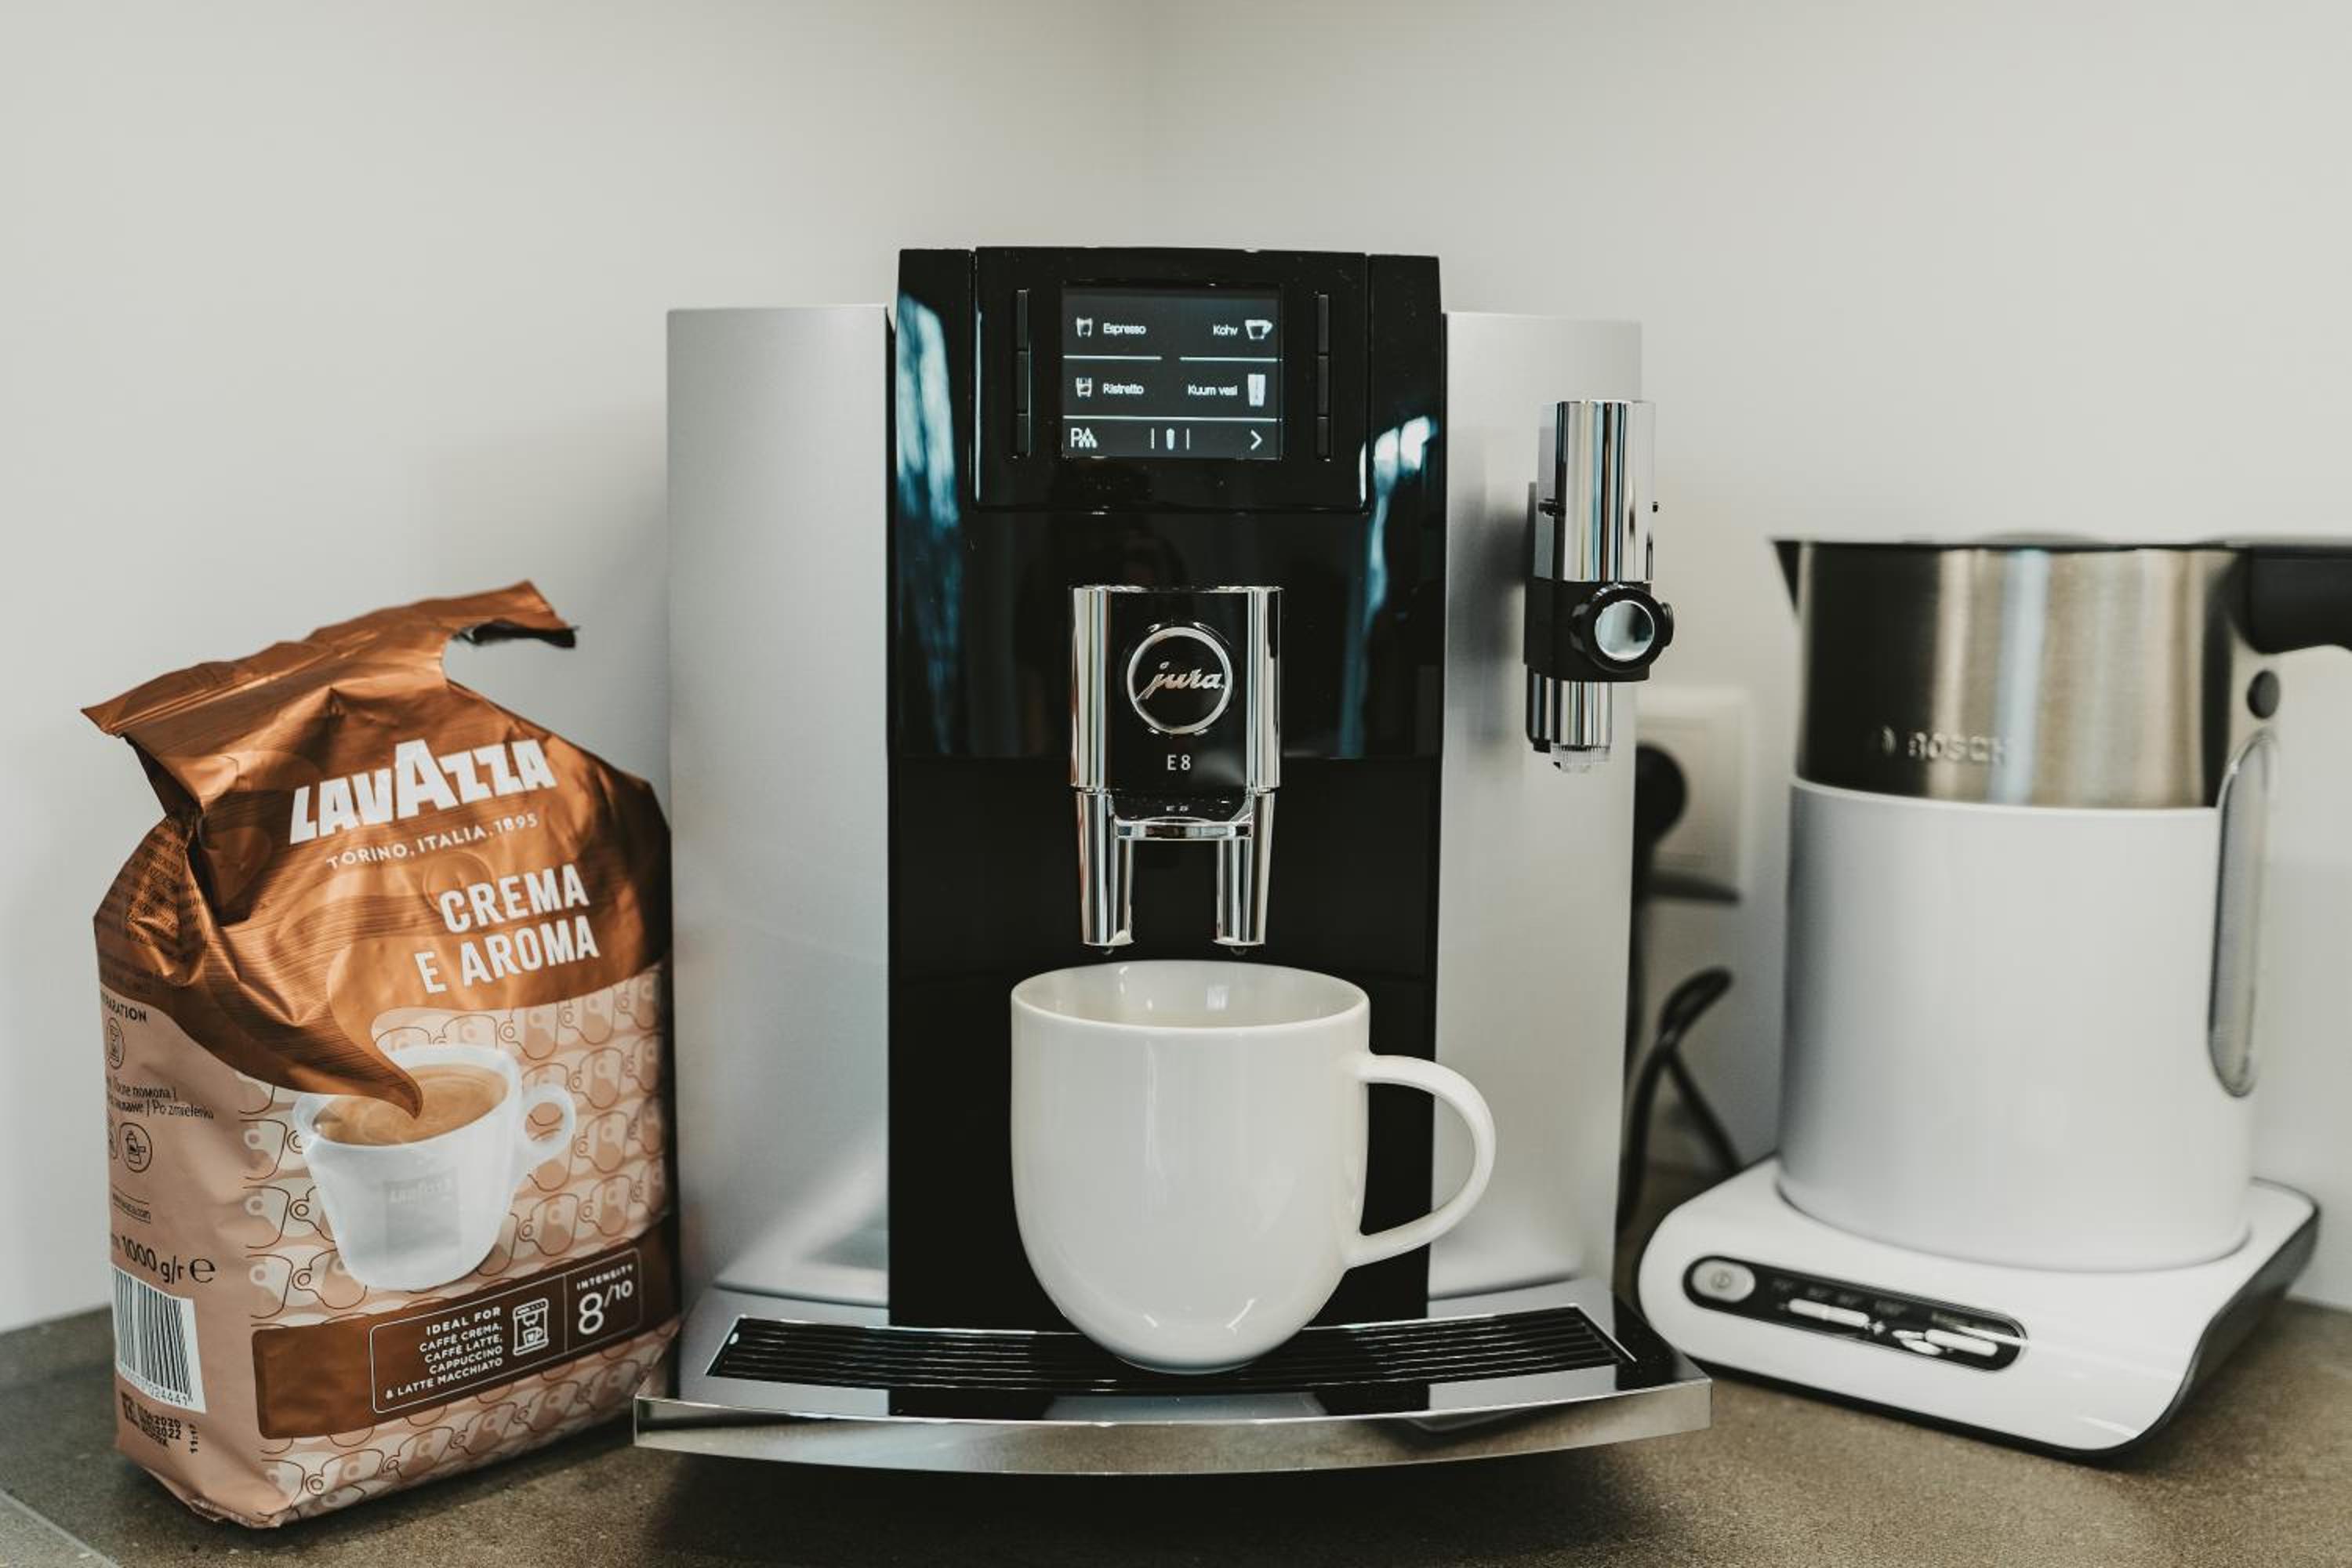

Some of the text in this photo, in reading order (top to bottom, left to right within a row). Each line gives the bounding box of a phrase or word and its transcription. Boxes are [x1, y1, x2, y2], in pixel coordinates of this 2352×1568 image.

[1102, 322, 1146, 336] Espresso
[1212, 324, 1239, 336] Kohv
[1102, 383, 1145, 394] Ristretto
[1188, 383, 1238, 396] Kuum vesi
[1134, 661, 1225, 702] jura
[1908, 731, 2013, 765] BOSCH
[495, 813, 539, 833] 1895
[439, 864, 590, 933] CREMA
[415, 916, 601, 993] E AROMA
[122, 1236, 157, 1272] 1000
[576, 1264, 633, 1291] INTENSITY
[426, 1307, 501, 1336] IDEAL FOR
[429, 1345, 503, 1374] CAPPUCCINO
[397, 1378, 434, 1396] LATTE
[437, 1357, 503, 1385] MACCHIATO
